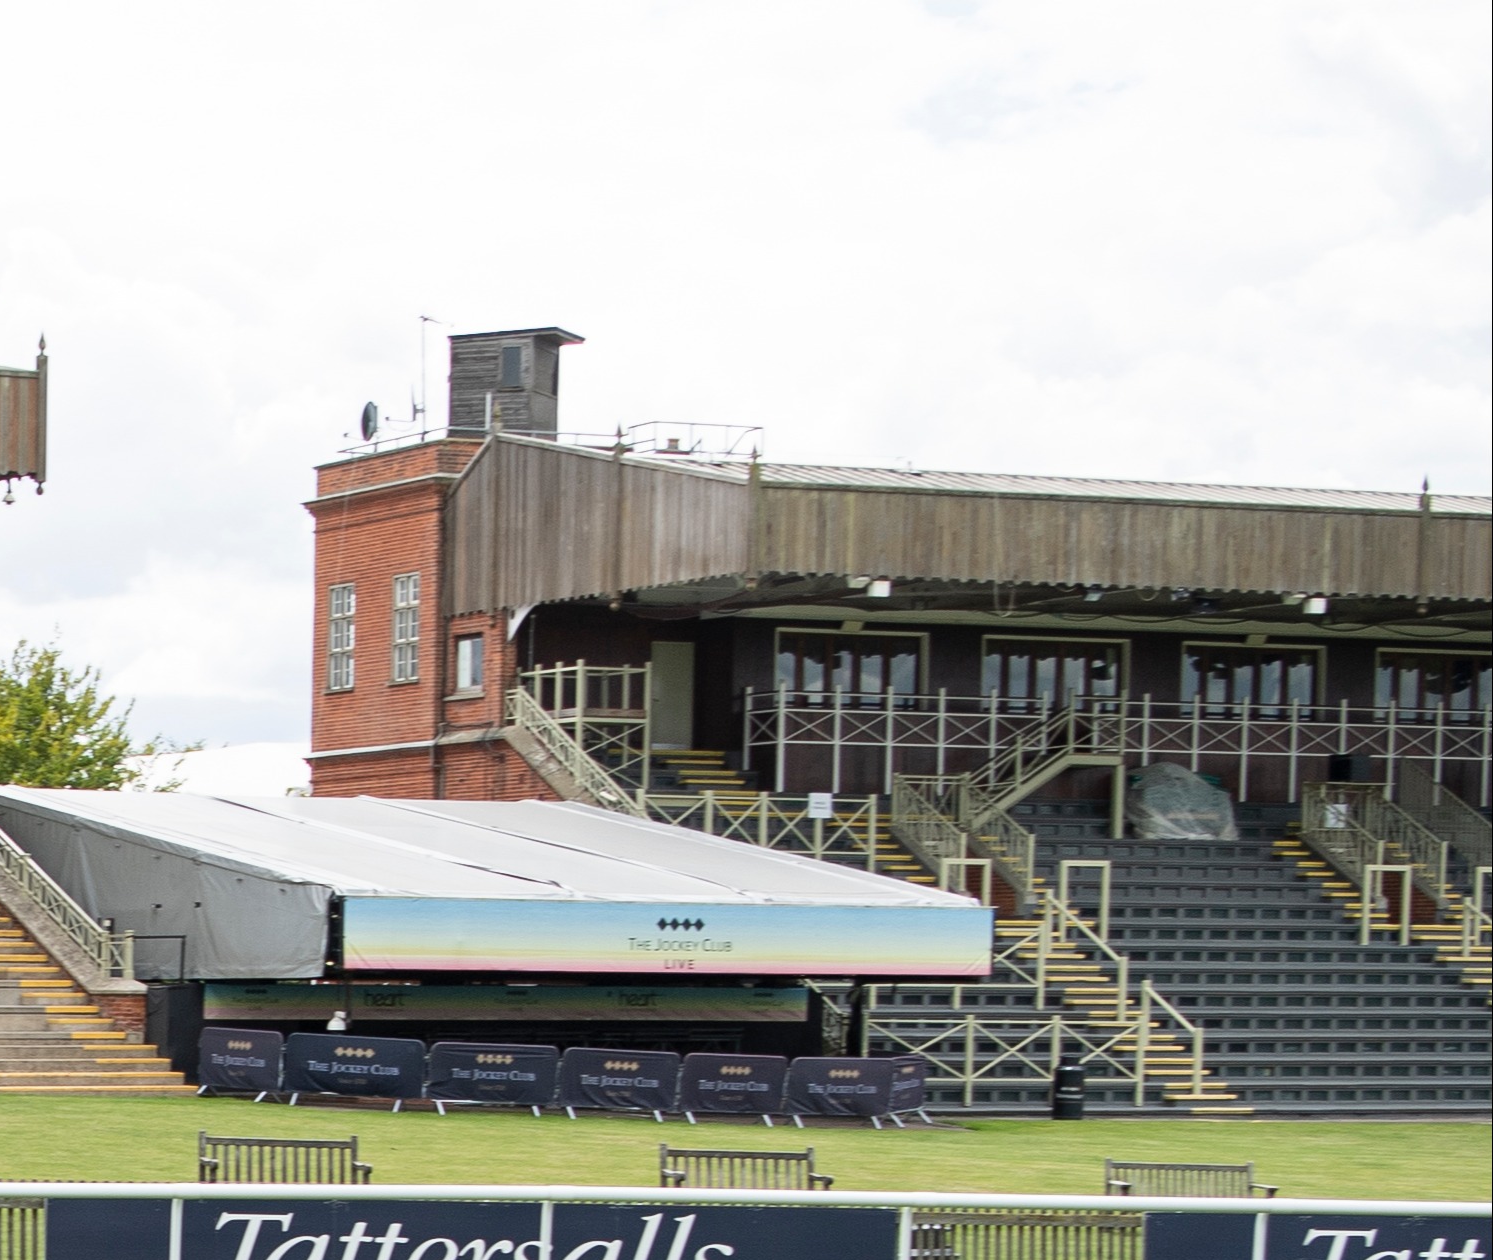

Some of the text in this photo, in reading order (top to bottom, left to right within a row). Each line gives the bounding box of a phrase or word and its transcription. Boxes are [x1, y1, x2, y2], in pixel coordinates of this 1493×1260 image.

[628, 938, 733, 953] THE JOCKEY CLUB
[665, 960, 695, 970] LIVE
[308, 1060, 400, 1076] THE JOCKEY CLUB
[451, 1068, 471, 1079] THE
